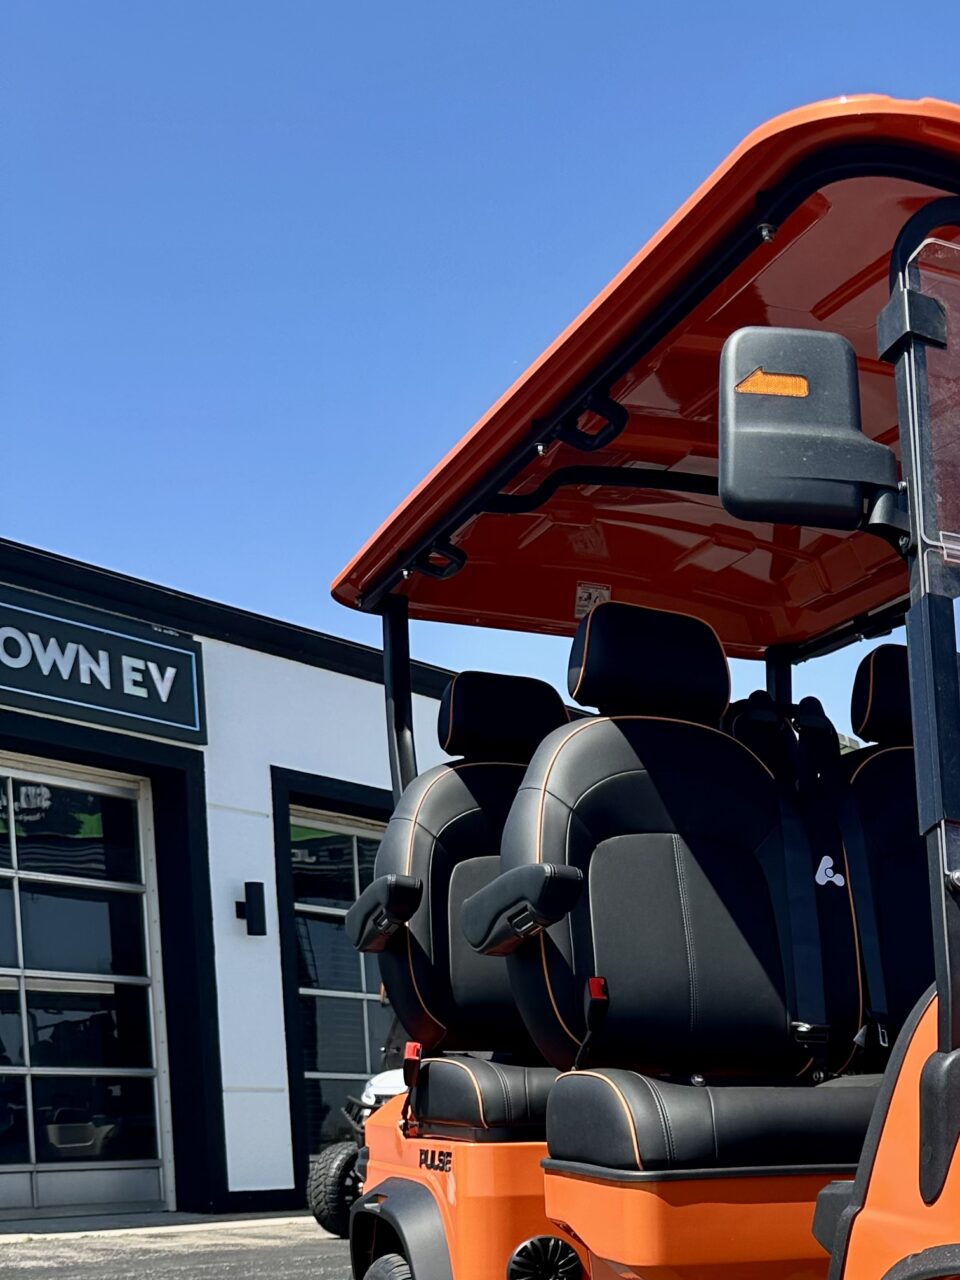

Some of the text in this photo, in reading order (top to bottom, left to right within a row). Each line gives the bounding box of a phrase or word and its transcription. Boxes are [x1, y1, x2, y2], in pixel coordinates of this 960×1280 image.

[0, 626, 177, 703] OWN EV
[419, 1149, 452, 1173] PULSE
